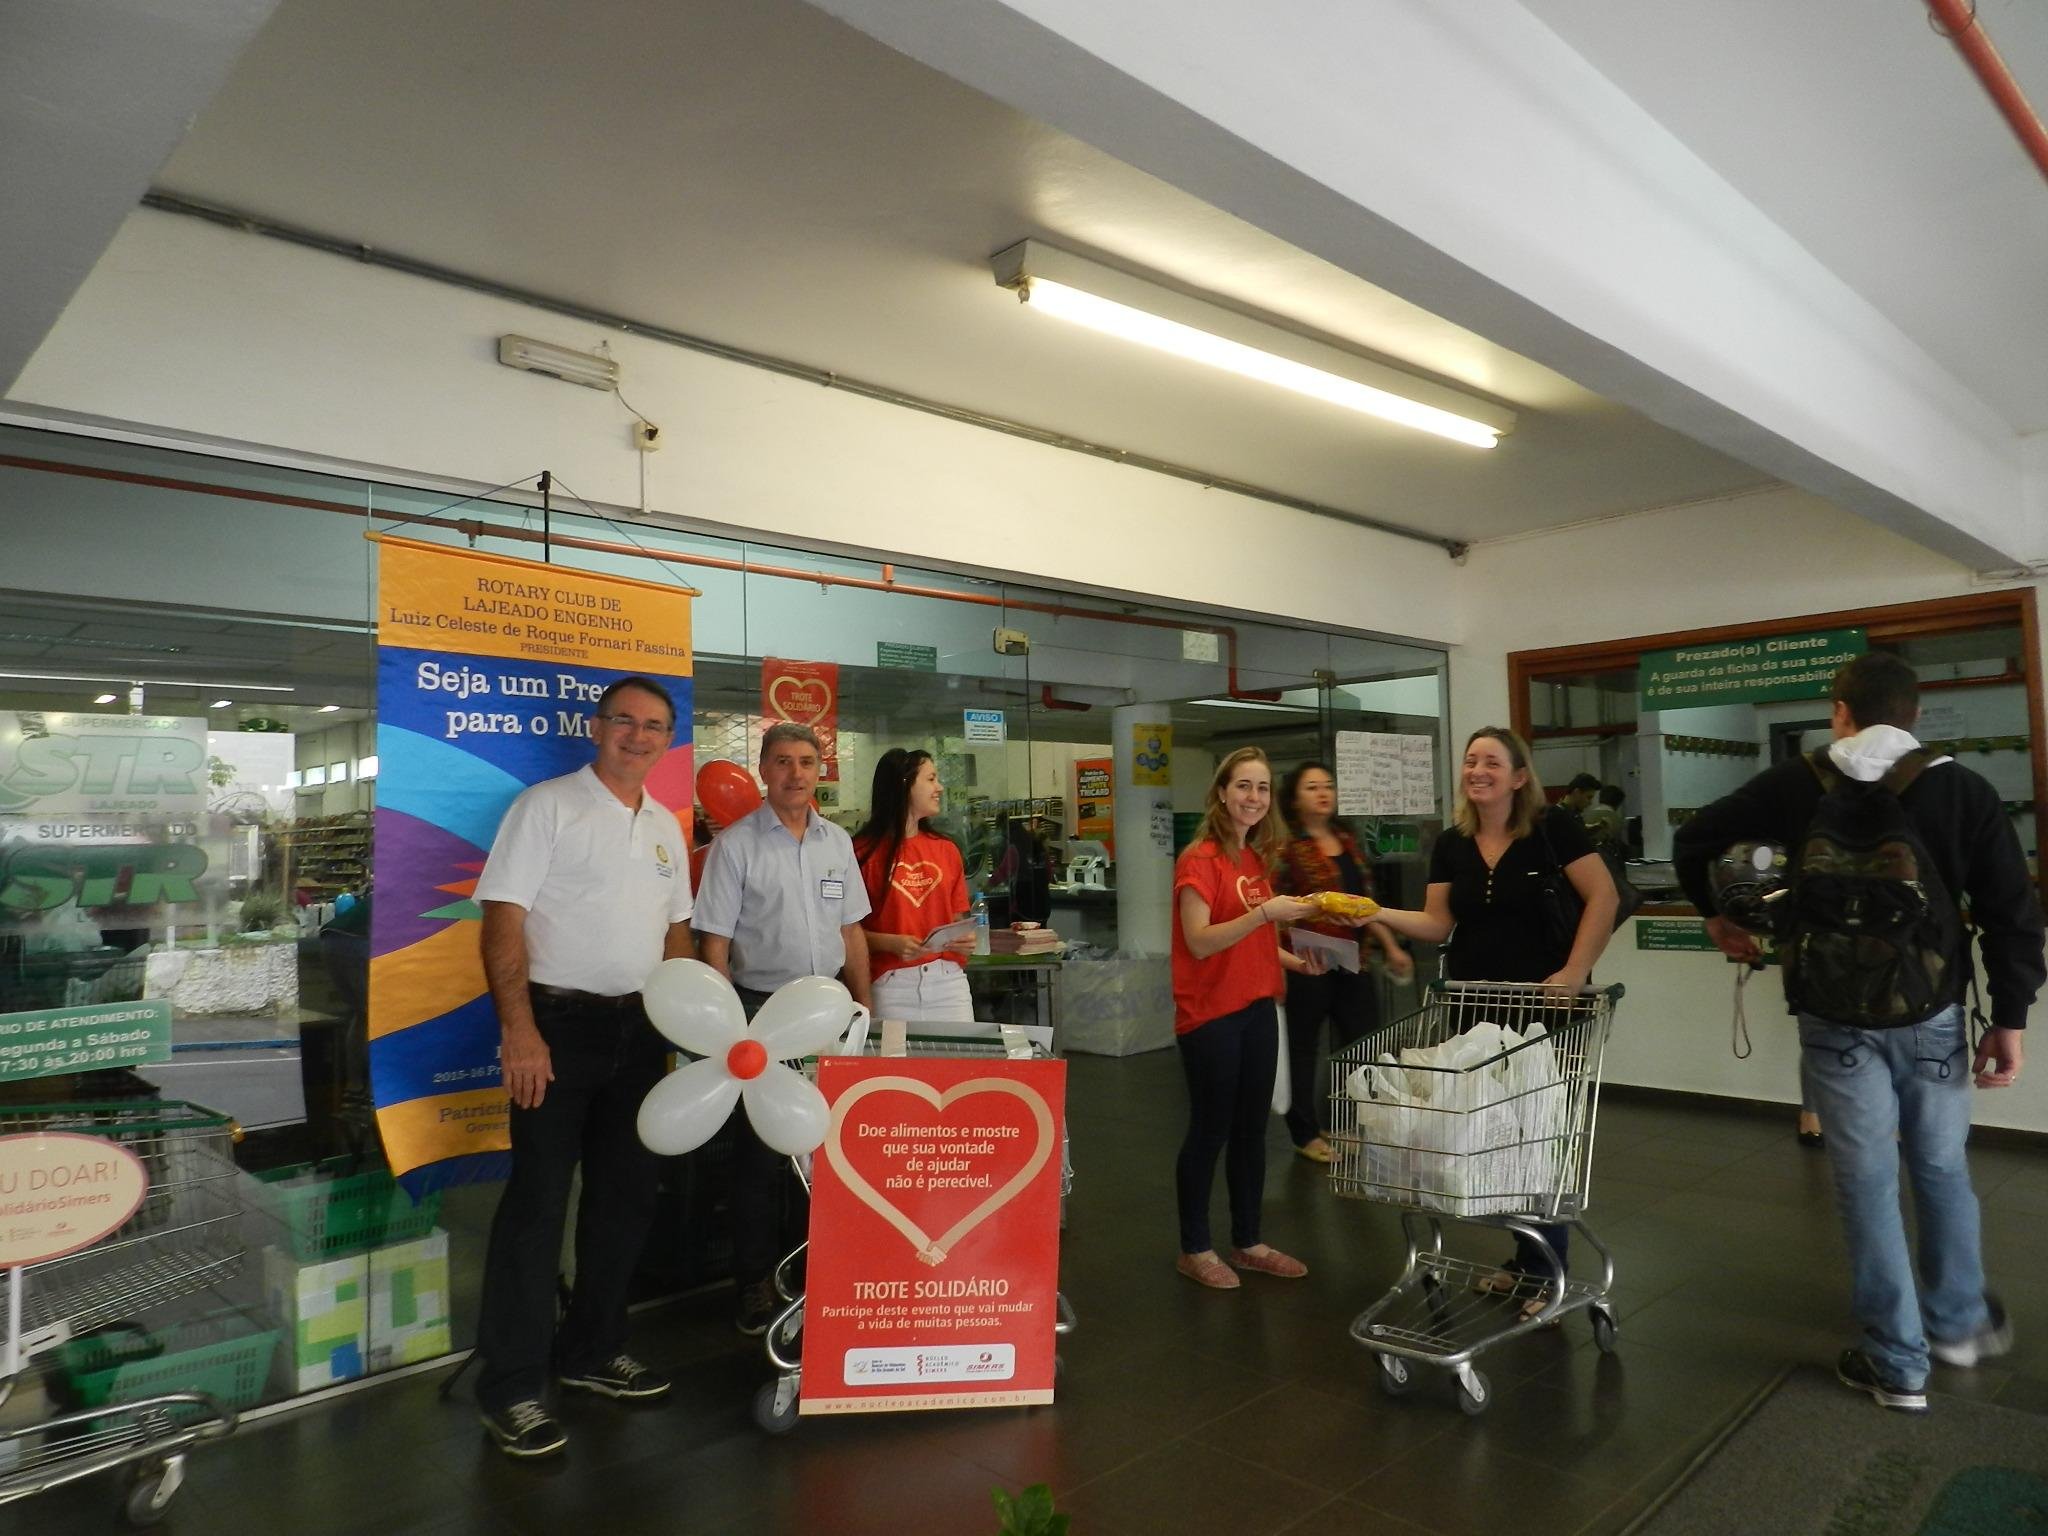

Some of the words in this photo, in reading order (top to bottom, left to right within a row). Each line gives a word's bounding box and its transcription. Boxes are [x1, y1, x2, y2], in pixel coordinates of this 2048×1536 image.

[477, 577, 551, 600] ROTARY
[555, 590, 596, 608] CLUB
[601, 598, 622, 612] DE
[463, 597, 549, 621] LAJEADO
[554, 611, 634, 633] ENGENHO
[389, 607, 431, 627] Luiz
[436, 614, 498, 634] Celeste
[503, 621, 521, 636] de
[527, 625, 575, 645] Roque
[579, 632, 632, 652] Fornari
[635, 639, 686, 658] Fassina
[519, 642, 589, 659] PRESIDENTE
[1676, 643, 1761, 662] Prezado(a)
[1766, 637, 1828, 652] Cliente
[1651, 671, 1662, 682] A
[1663, 668, 1706, 684] guarda
[1709, 665, 1725, 677] da
[1727, 661, 1757, 675] ficha
[1761, 658, 1779, 671] da
[1782, 656, 1806, 668] sua
[417, 661, 491, 699] Seja
[499, 674, 549, 698] um
[557, 674, 609, 703] Pre
[1658, 684, 1673, 697] de
[1675, 682, 1699, 695] sua
[1701, 679, 1741, 693] inteira
[61, 717, 182, 730] SUPERMERCADO
[446, 710, 523, 739] para
[530, 715, 549, 736] o
[970, 713, 999, 722] AVISO
[4, 734, 205, 796] STR
[0, 843, 208, 910] STR
[26, 1020, 47, 1032] DE
[72, 1037, 82, 1048] a
[87, 1029, 151, 1046] Sábado
[69, 1048, 116, 1064] 20:00
[120, 1045, 147, 1058] hrs
[858, 1123, 887, 1138] Doe
[890, 1123, 958, 1139] alimentos
[961, 1127, 970, 1138] e
[973, 1125, 1020, 1139] mostre
[883, 1143, 909, 1158] que
[912, 1143, 936, 1154] sua
[939, 1140, 995, 1155] vontade
[30, 1160, 118, 1191] DOAR!
[906, 1157, 924, 1171] de
[927, 1157, 971, 1175] ajudar
[886, 1175, 913, 1189] não
[915, 1174, 925, 1188] é
[928, 1174, 993, 1192] perecível.
[854, 1281, 909, 1300] TROTE
[915, 1276, 1009, 1298] SOLIDÁRIO
[822, 1304, 874, 1319] Participe
[876, 1304, 908, 1317] deste
[911, 1305, 951, 1316] evento
[954, 1304, 975, 1317] que
[978, 1302, 995, 1314] vai
[998, 1301, 1034, 1313] mudar
[858, 1320, 865, 1330] a
[868, 1317, 894, 1330] vida
[896, 1317, 911, 1329] de
[914, 1316, 952, 1329] muitas
[955, 1317, 1002, 1330] pessoas.
